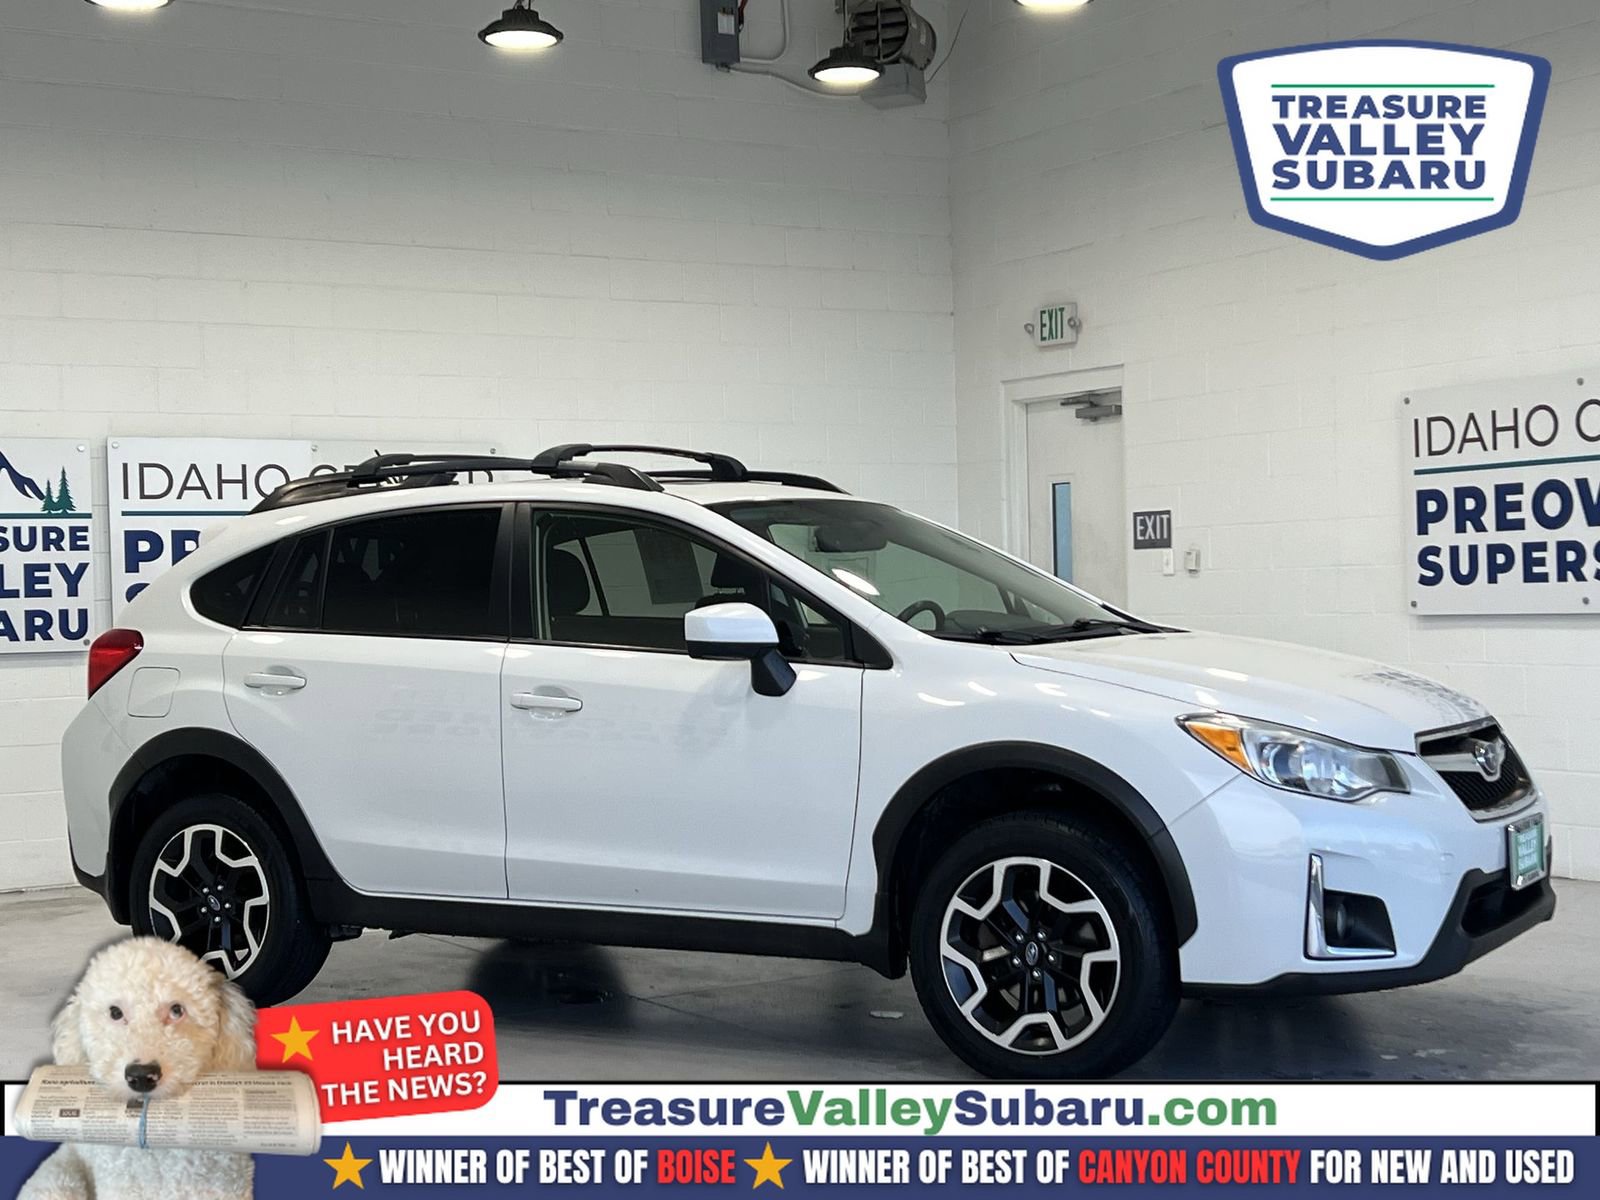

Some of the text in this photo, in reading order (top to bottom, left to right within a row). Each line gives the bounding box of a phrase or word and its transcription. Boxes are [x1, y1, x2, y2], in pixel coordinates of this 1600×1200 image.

[1040, 307, 1065, 341] EXIT
[1414, 404, 1559, 458] IDAHO
[122, 462, 289, 501] IDAHO
[1136, 514, 1170, 540] EXIT
[1418, 540, 1600, 587] SUPER
